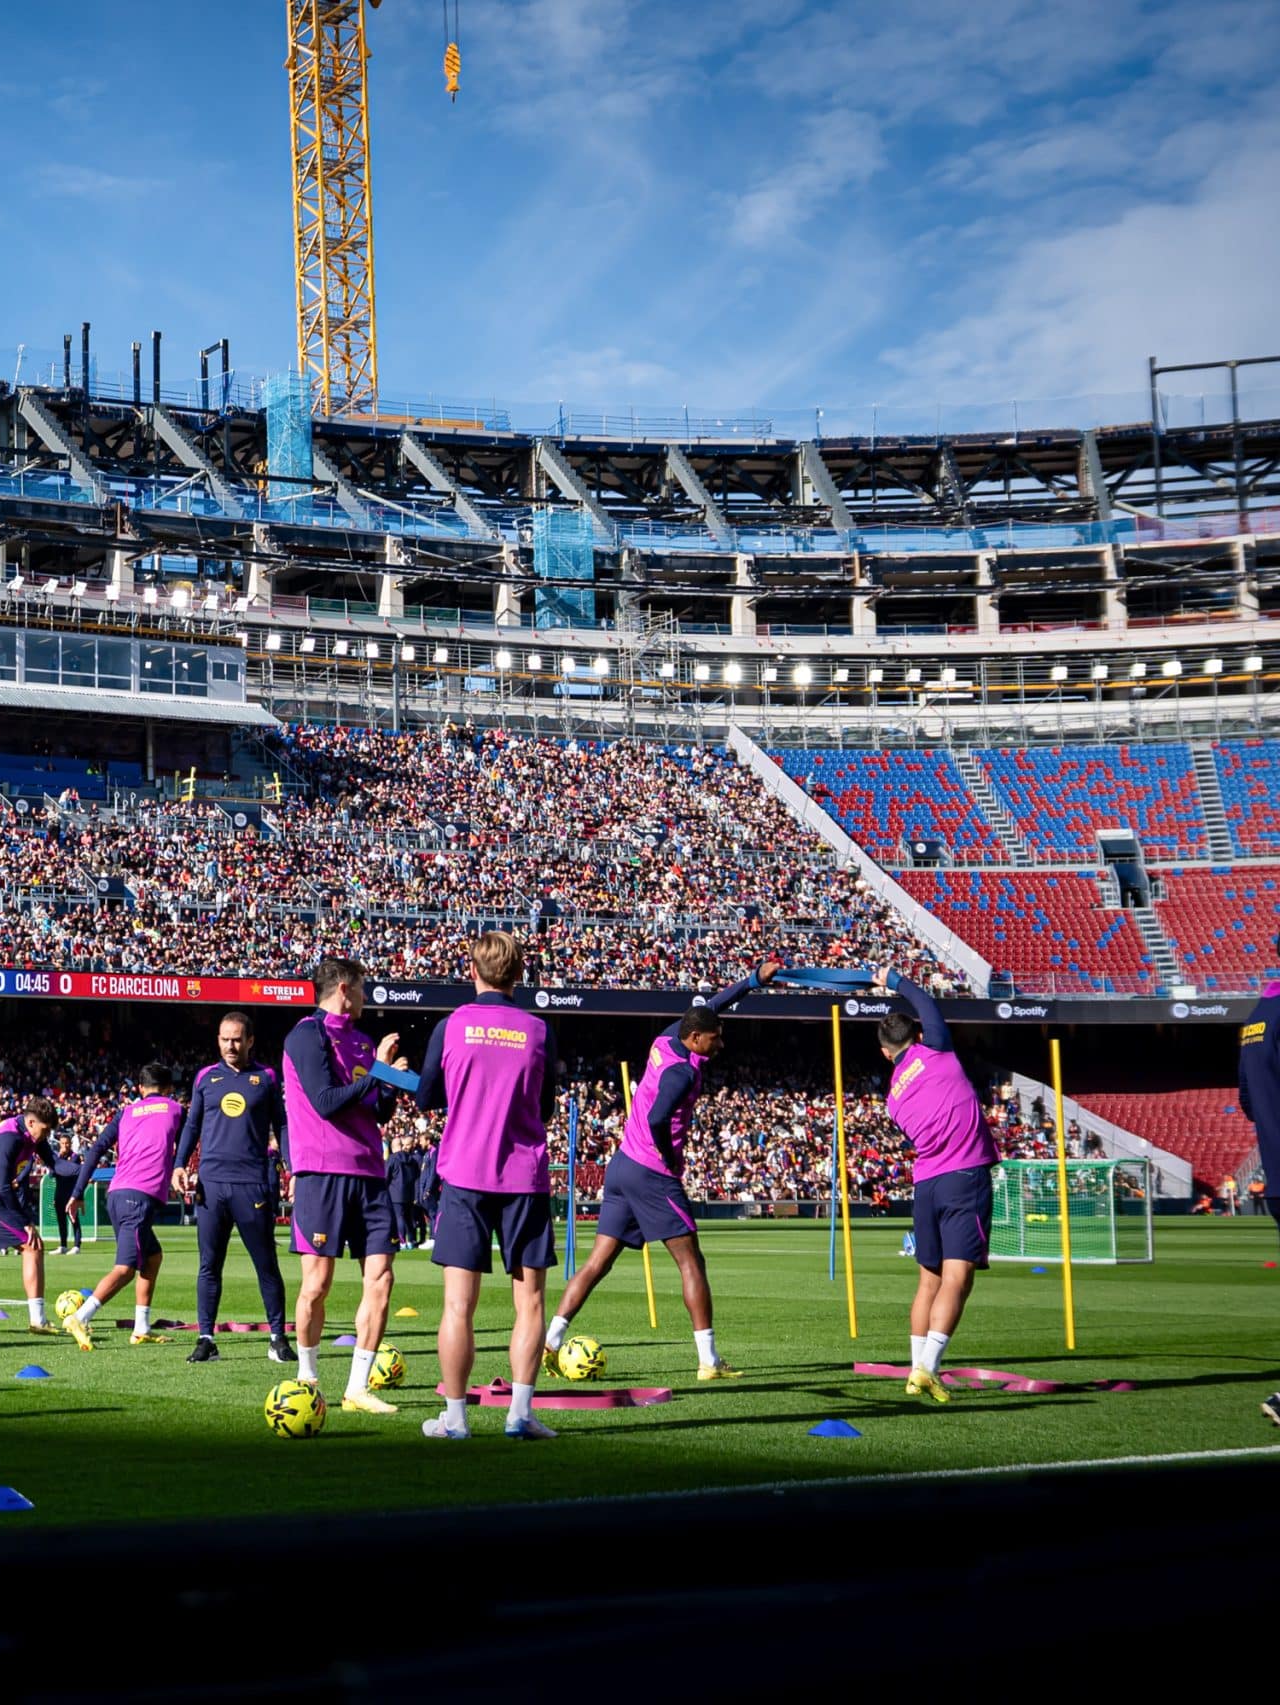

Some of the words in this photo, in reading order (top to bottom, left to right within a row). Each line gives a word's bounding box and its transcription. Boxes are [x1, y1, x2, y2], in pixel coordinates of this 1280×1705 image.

[15, 973, 50, 993] 04:45
[59, 974, 73, 994] 0
[91, 976, 107, 995] FC
[109, 977, 180, 997] BARCELONA
[263, 985, 305, 997] ESTRELLA
[388, 989, 422, 1003] Spotify
[550, 994, 583, 1007] Spotify
[860, 1002, 891, 1015] Spotify
[1014, 1005, 1048, 1018] Spotify
[1191, 1005, 1228, 1018] Spotify
[487, 1027, 527, 1042] CONGO
